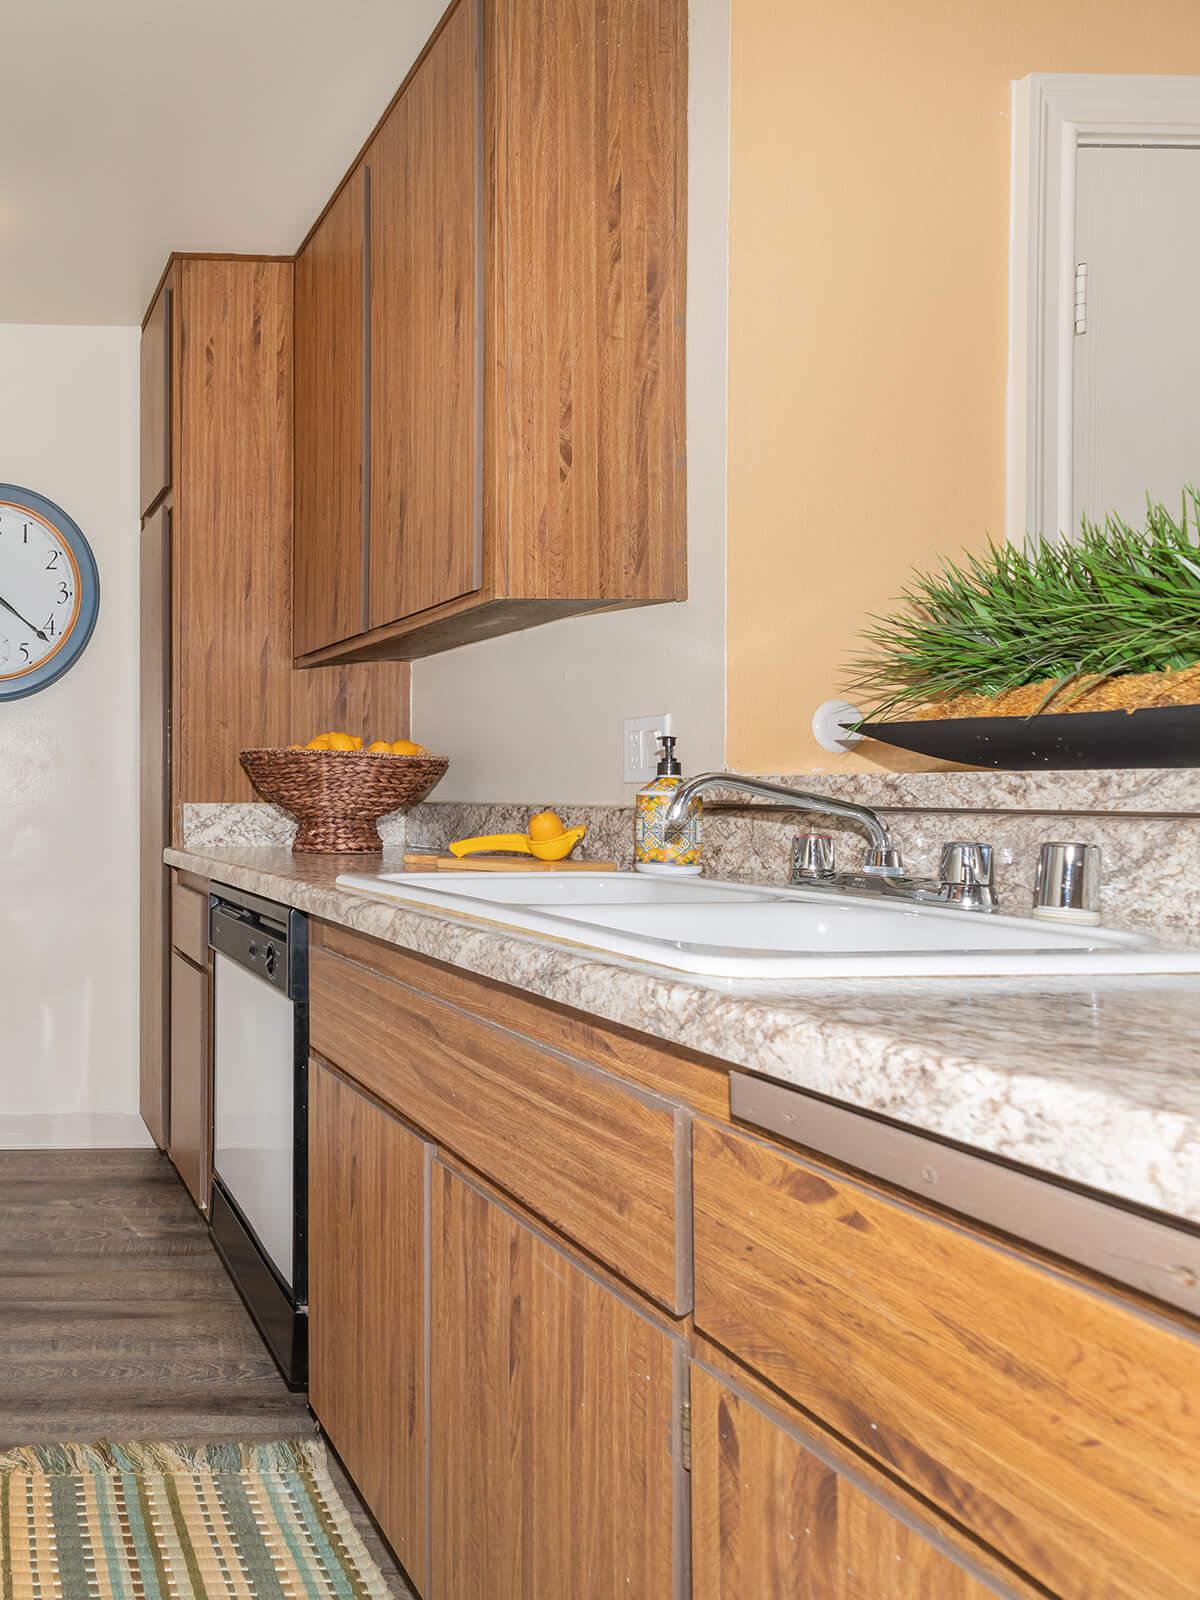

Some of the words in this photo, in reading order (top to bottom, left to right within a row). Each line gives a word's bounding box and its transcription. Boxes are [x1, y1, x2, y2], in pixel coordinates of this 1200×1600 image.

[22, 523, 28, 543] 1
[45, 550, 58, 570] 2
[57, 582, 69, 604] 3
[42, 613, 56, 635] 4
[19, 643, 29, 662] 5
